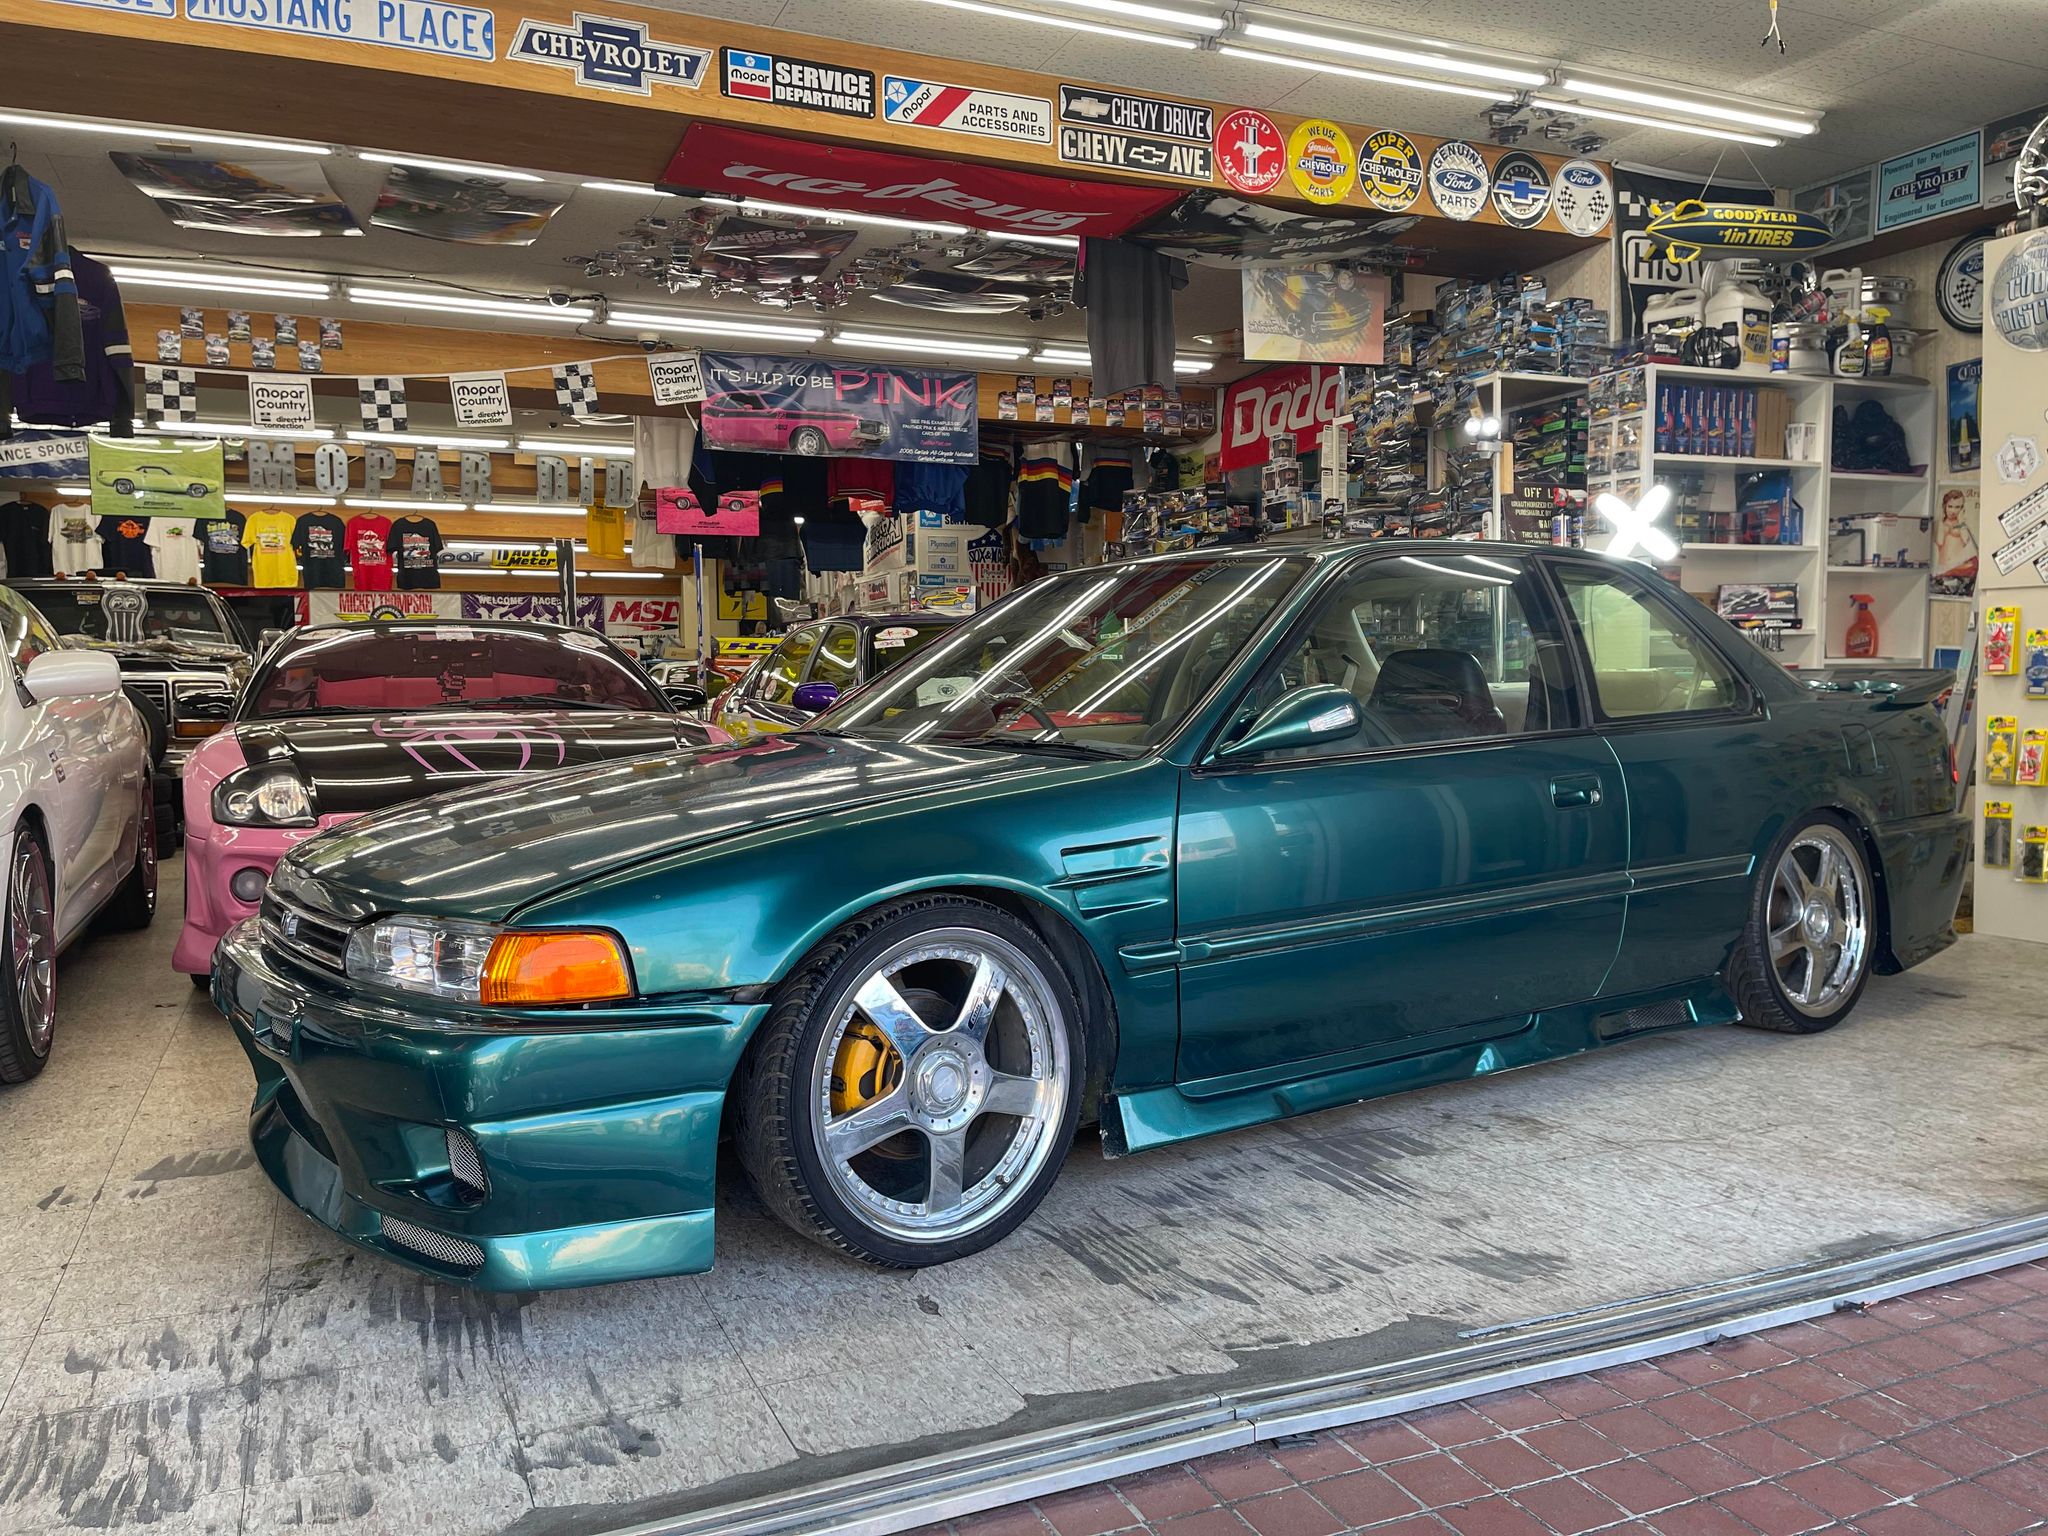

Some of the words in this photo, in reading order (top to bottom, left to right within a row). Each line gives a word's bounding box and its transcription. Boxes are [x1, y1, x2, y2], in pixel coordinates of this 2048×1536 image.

[378, 0, 479, 53] PLACE
[531, 31, 691, 78] CHEVROLET
[730, 69, 770, 84] Mopar
[775, 62, 872, 98] SERVICE
[774, 85, 872, 114] DEPARTMENT
[902, 87, 932, 120] Mopar
[968, 103, 1008, 119] PARTS
[1012, 109, 1038, 123] AND
[1111, 98, 1158, 133] CHEVY
[1162, 106, 1205, 139] DRIVE
[962, 115, 1045, 137] ACCESSORIES
[1230, 117, 1271, 135] FORD
[1307, 126, 1320, 136] WE
[1322, 127, 1337, 140] USE
[1063, 130, 1127, 164] CHEVY
[1169, 146, 1211, 177] AVE.
[1308, 141, 1336, 153] Genuine
[1369, 133, 1414, 159] SUPER
[1300, 159, 1345, 174] CHEVROLET
[1434, 145, 1485, 174] GENUINE
[1884, 162, 1913, 176] Powered
[1917, 156, 1927, 165] for
[1930, 140, 1977, 161] Performance
[1223, 155, 1279, 187] MUSTANG
[1363, 161, 1419, 182] CHEVROLET
[1569, 169, 1594, 186] Ford
[1444, 171, 1473, 190] Ford
[1894, 168, 1964, 198] CHEVROLET
[1308, 184, 1335, 197] PARTS
[1365, 180, 1415, 205] SERVICE
[1440, 194, 1477, 208] PARTS
[1884, 206, 1923, 224] Engineered
[1927, 203, 1936, 212] for
[1940, 192, 1974, 208] Economy
[1713, 207, 1797, 224] GOODYEAR
[1747, 228, 1795, 246] TIRES
[654, 364, 693, 376] Mopar
[656, 374, 696, 385] Country
[255, 387, 305, 400] Mopar
[456, 385, 501, 396] Mopar
[666, 394, 698, 402] connection
[710, 368, 741, 382] IT'S
[746, 371, 783, 386] H.I.P.
[787, 375, 807, 387] TO
[811, 376, 834, 389] BE
[832, 370, 970, 410] PINK
[256, 400, 306, 412] Country
[458, 396, 503, 406] Country
[1231, 365, 1341, 448] Dodg
[264, 421, 304, 429] connection
[248, 441, 493, 503] MOPAR
[1524, 487, 1543, 499] OFF
[930, 540, 957, 550] Plymouth
[507, 556, 557, 567] Meter
[921, 575, 944, 585] Plymouth
[339, 593, 377, 613] MICKEY
[379, 593, 433, 614] THOMPSON
[477, 595, 524, 605] WELCOME
[608, 600, 680, 622] MSD
